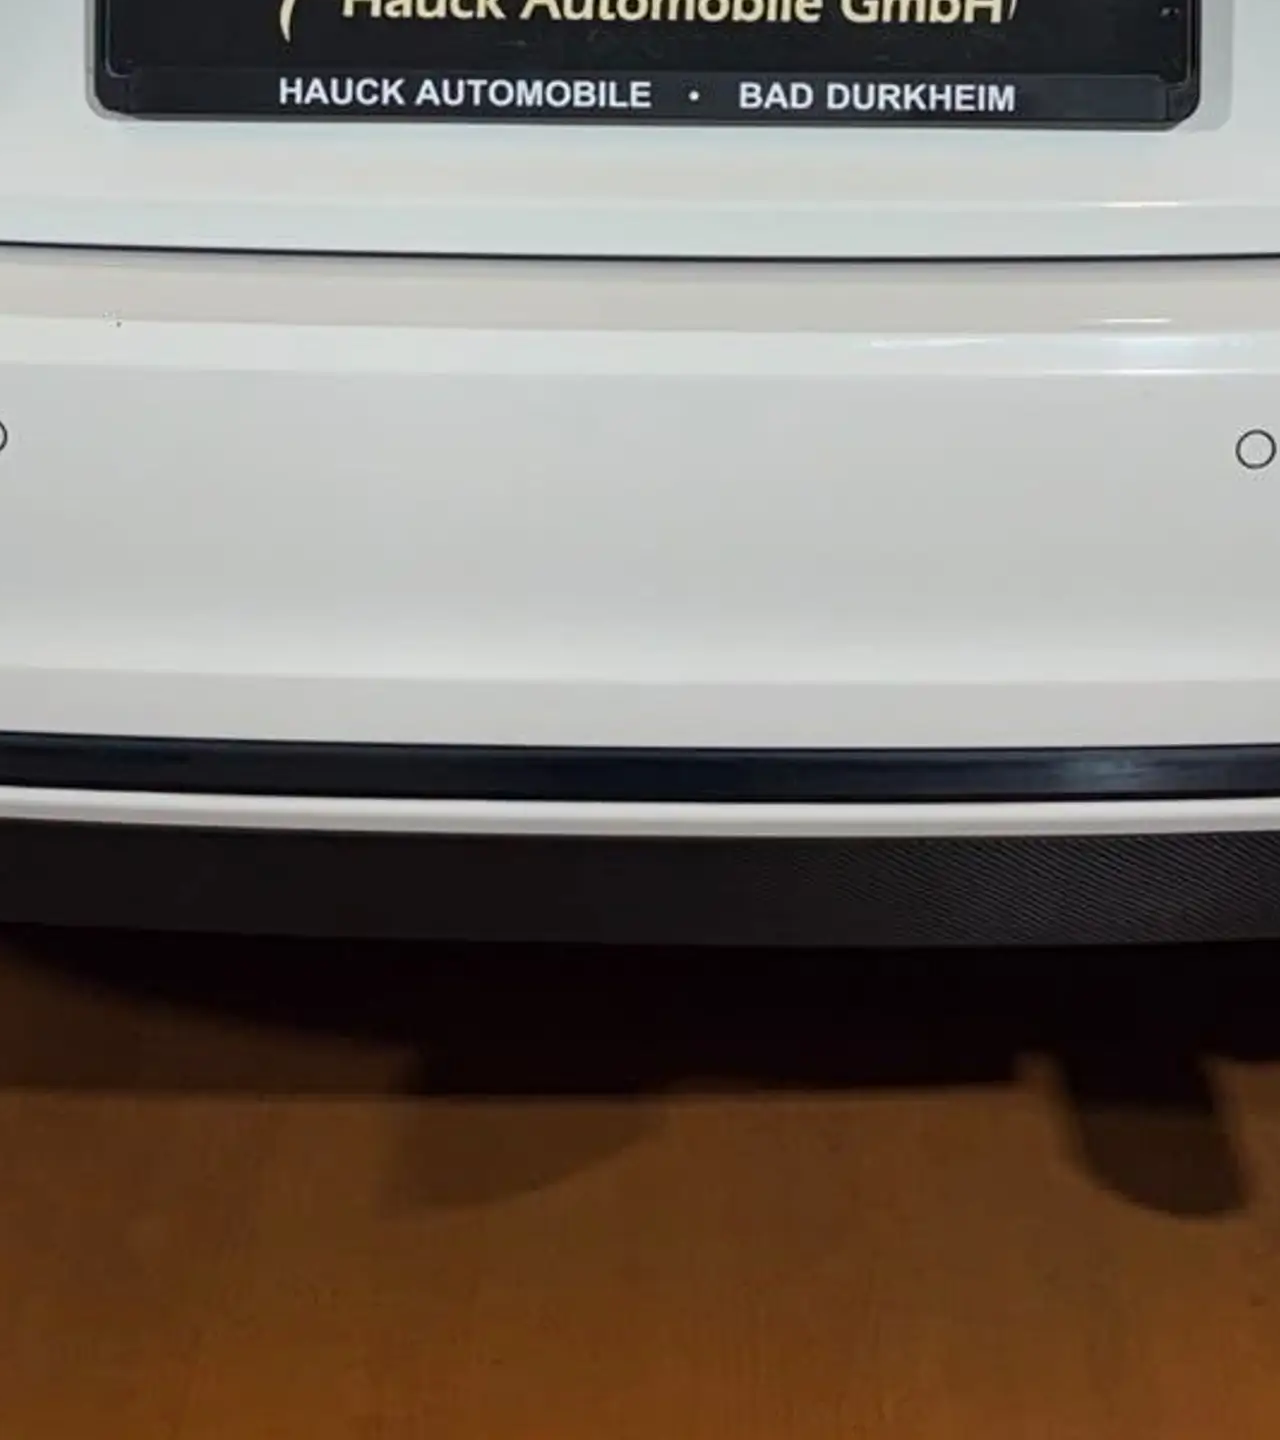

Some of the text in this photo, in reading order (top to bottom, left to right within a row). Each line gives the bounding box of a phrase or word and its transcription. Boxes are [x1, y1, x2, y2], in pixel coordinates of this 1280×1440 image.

[279, 76, 1016, 112] HAUCK AUTOMOBILE BAD DURKHEIM
